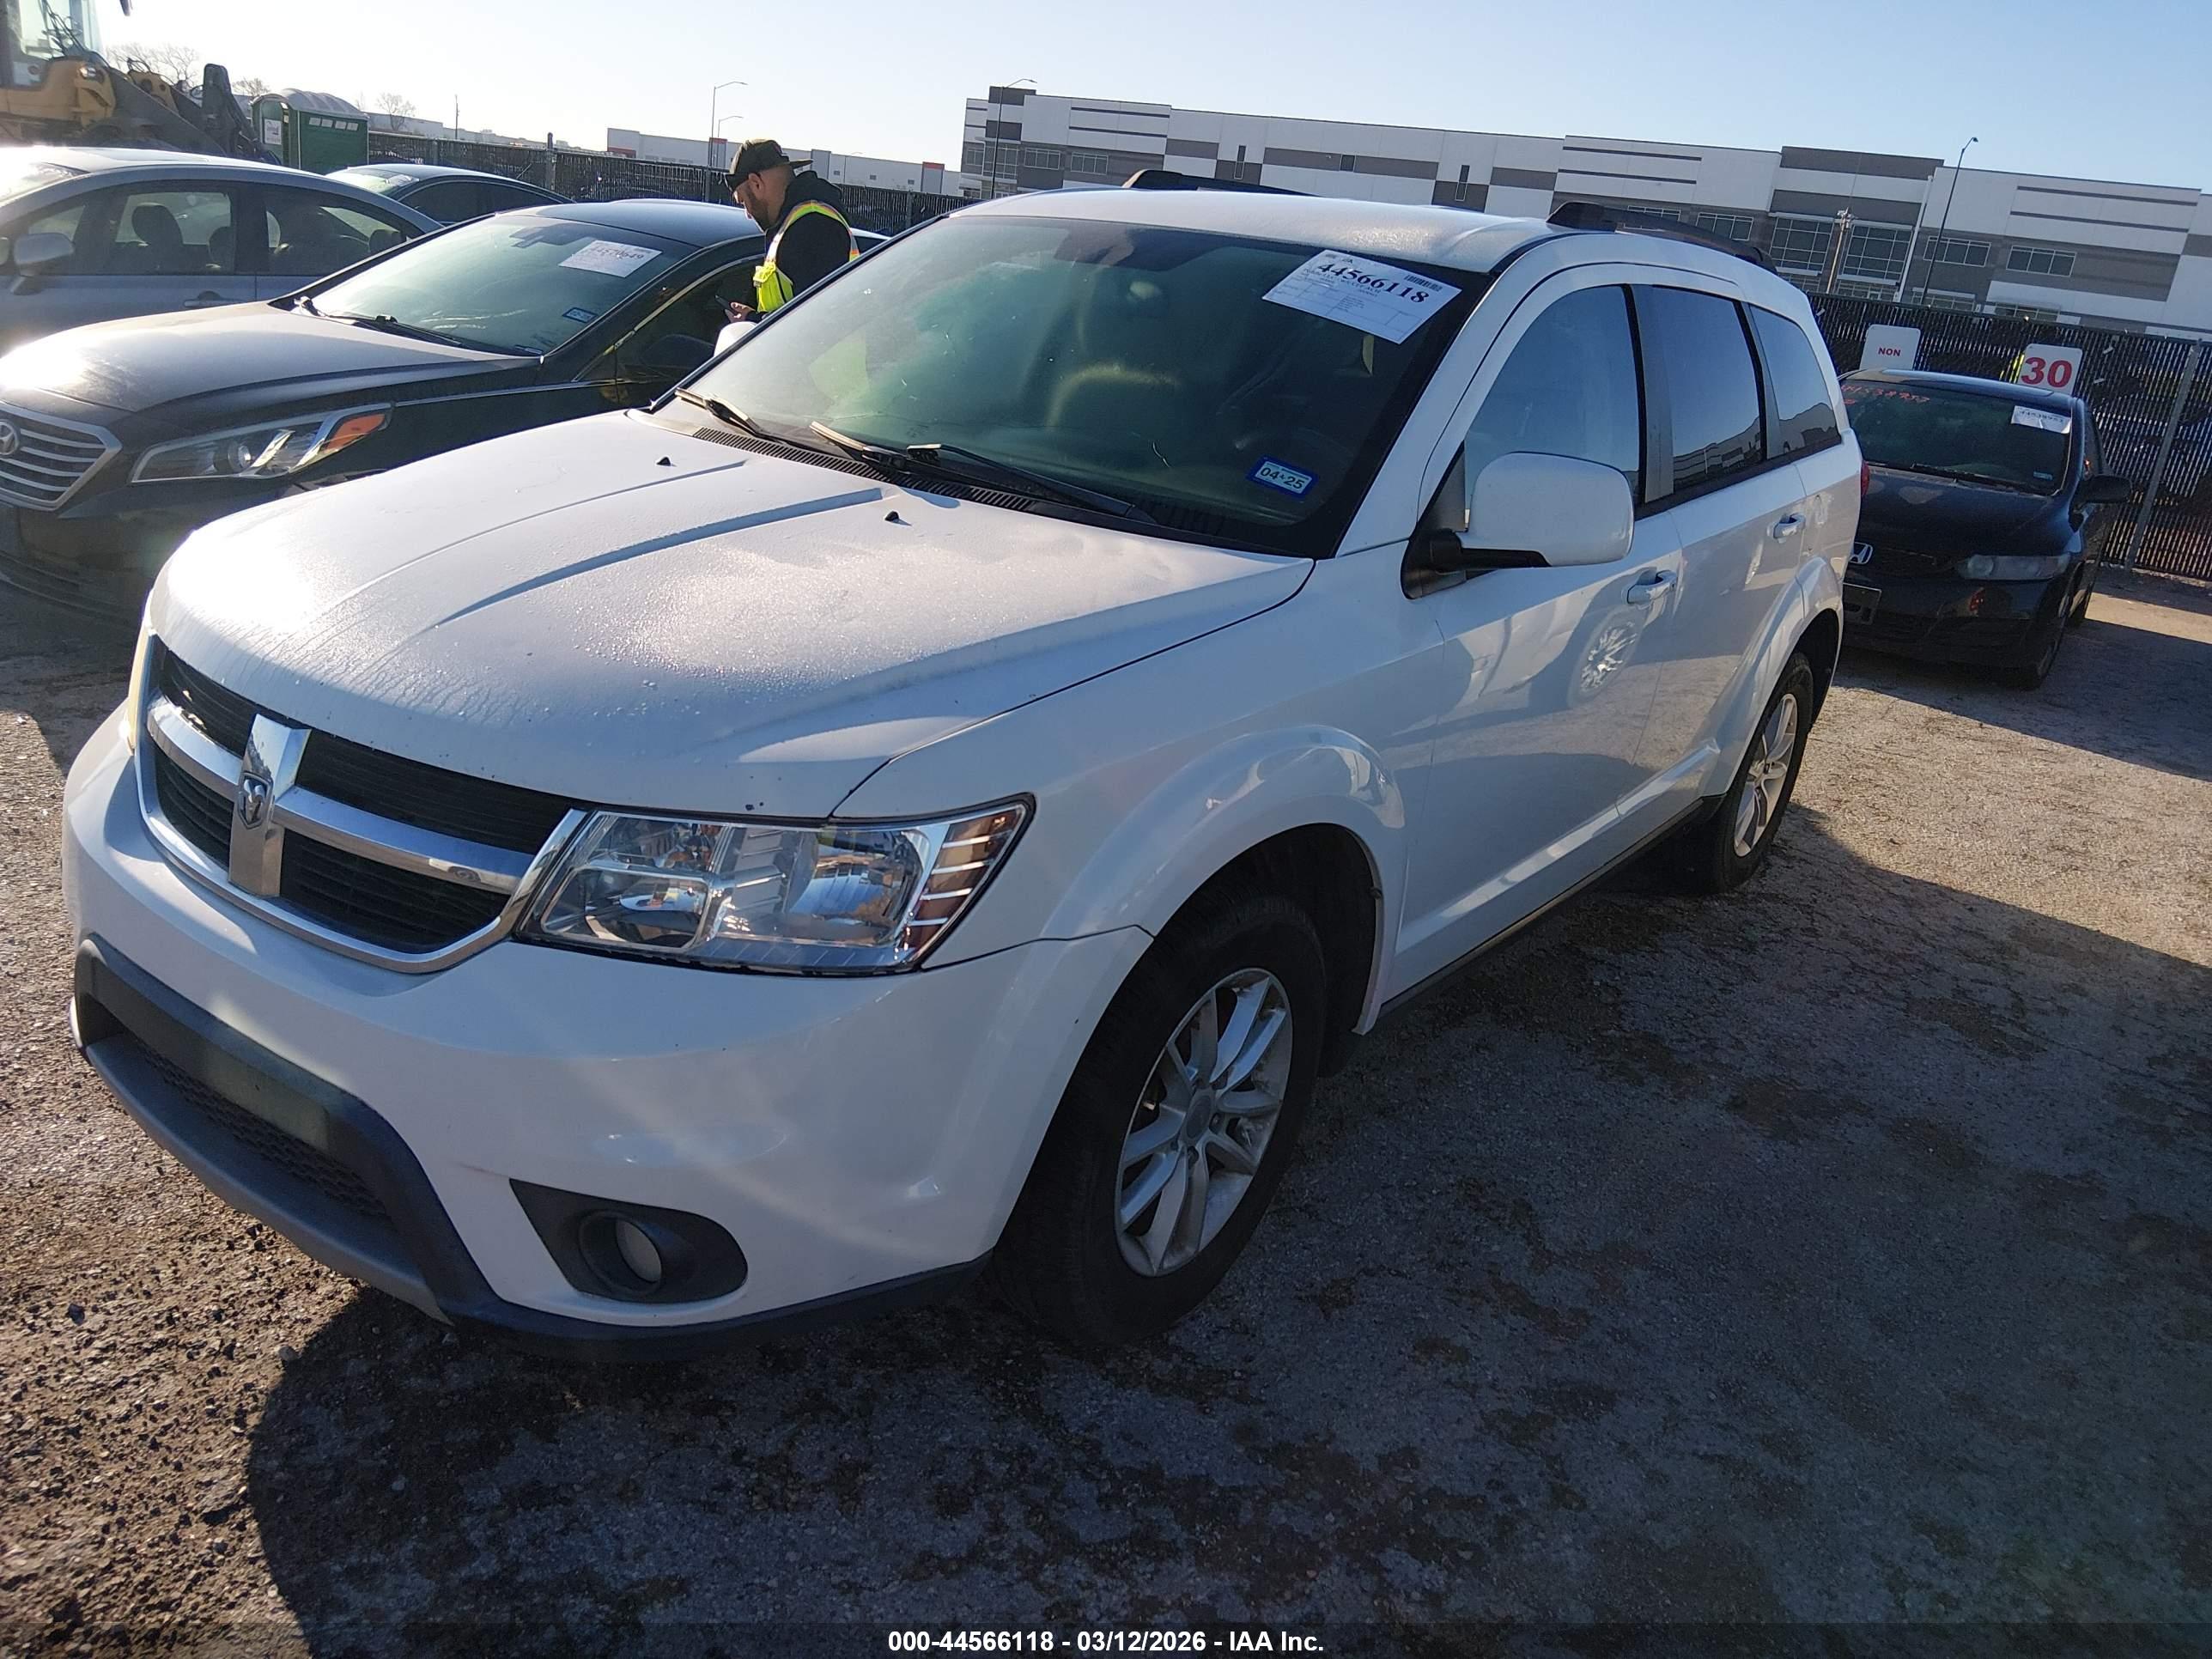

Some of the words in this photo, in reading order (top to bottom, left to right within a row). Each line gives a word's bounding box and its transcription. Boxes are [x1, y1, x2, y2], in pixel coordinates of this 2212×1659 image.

[1318, 264, 1430, 303] 44566118
[1877, 347, 1901, 356] NON
[2021, 357, 2073, 388] 30
